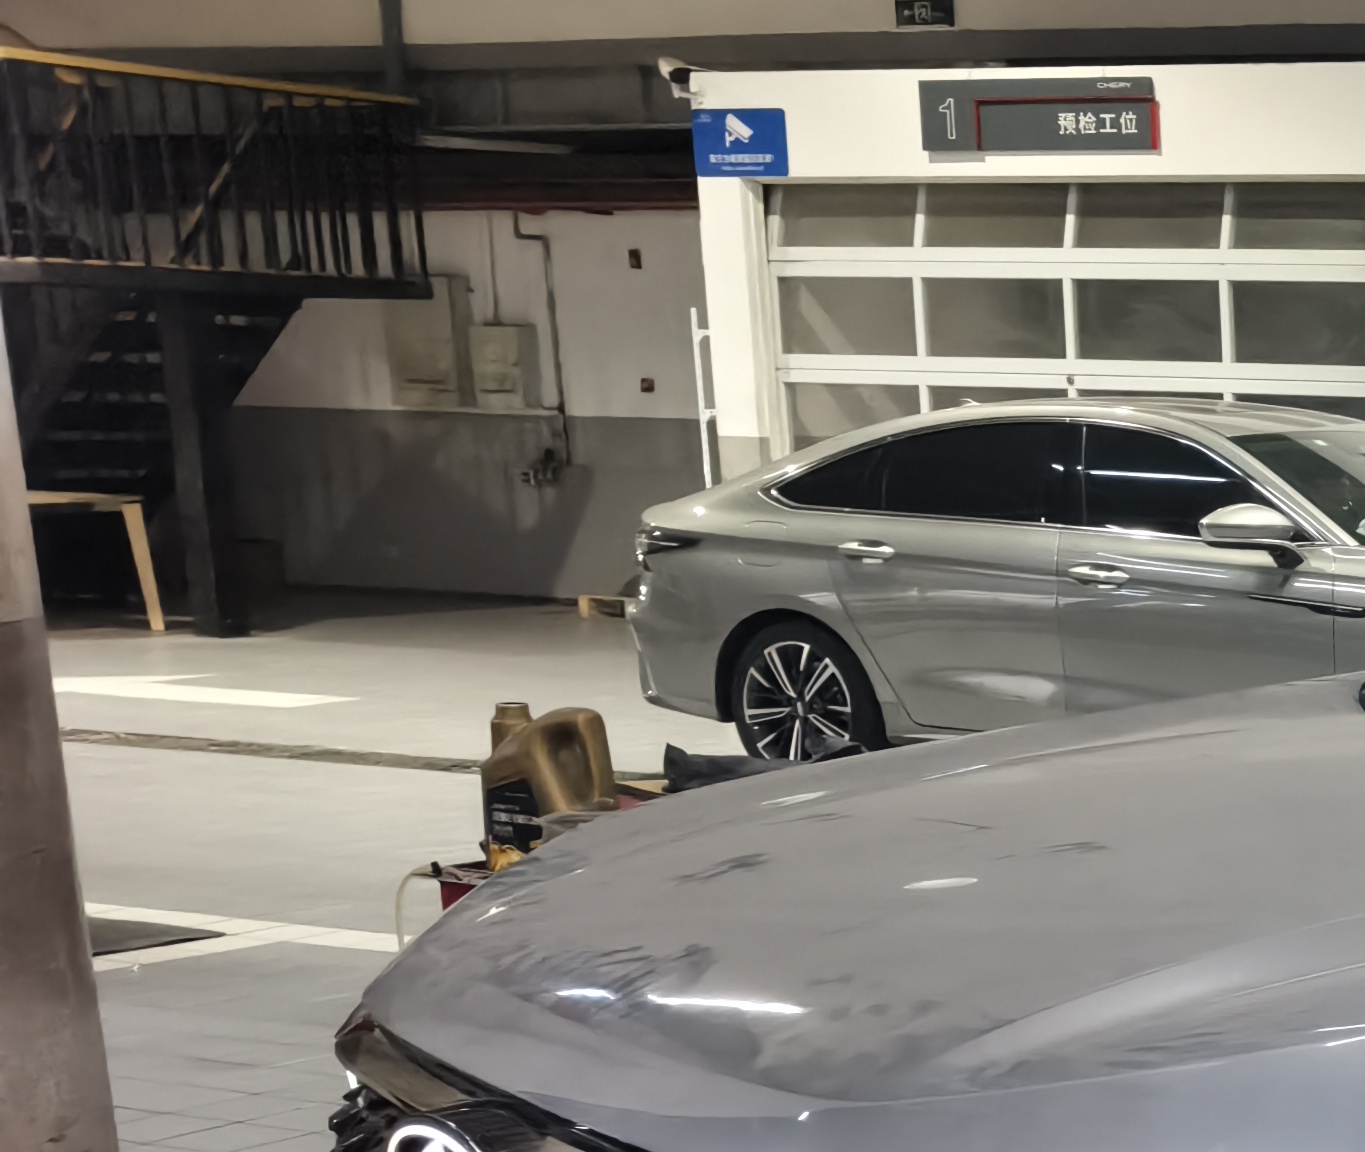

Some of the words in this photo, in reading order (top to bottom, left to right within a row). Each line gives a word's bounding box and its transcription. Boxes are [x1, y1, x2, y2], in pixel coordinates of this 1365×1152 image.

[938, 97, 956, 140] 1
[1057, 111, 1138, 135] 预检工位
